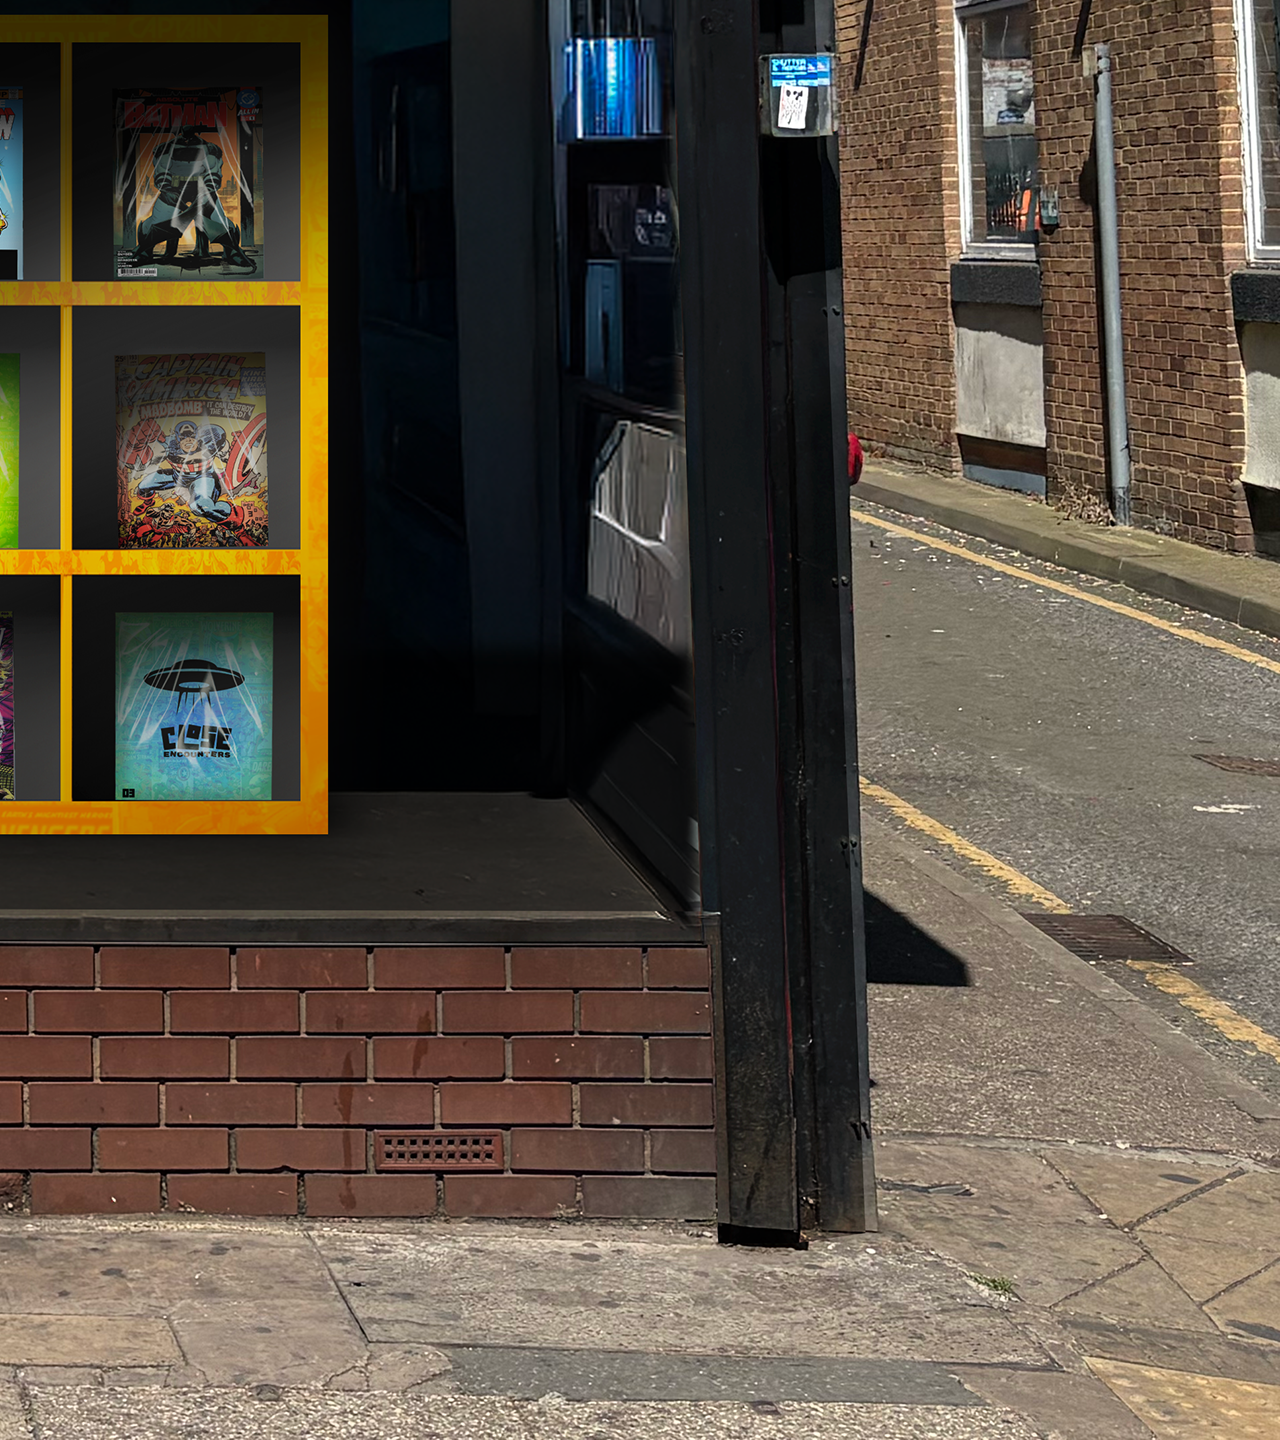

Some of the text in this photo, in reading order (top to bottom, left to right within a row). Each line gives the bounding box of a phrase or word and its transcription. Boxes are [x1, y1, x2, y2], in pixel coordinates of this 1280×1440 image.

[124, 101, 227, 128] BATMAN
[134, 353, 247, 380] CAPTAIN
[160, 724, 232, 751] CLOSE
[163, 750, 231, 758] ENCOUNTERS
[122, 788, 135, 798] 03
